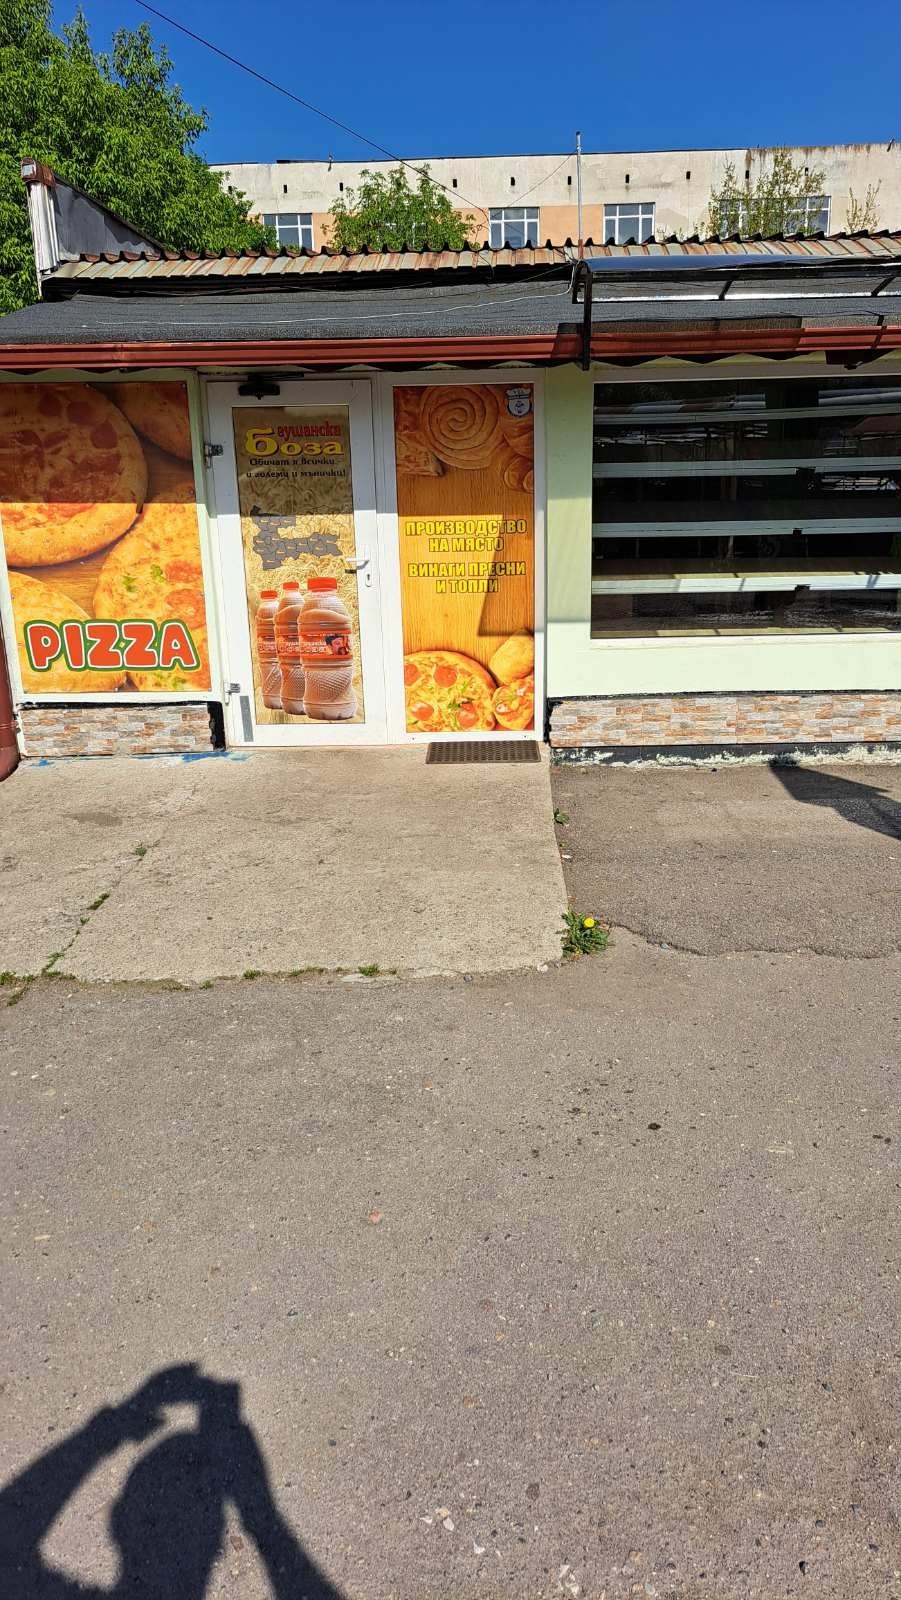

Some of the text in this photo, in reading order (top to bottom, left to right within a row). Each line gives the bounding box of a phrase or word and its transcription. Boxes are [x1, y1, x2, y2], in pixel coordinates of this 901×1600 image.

[405, 519, 527, 536] ПРОИЗВОДСТВО
[429, 537, 504, 552] НА МЯСТО
[408, 561, 526, 577] ВИНАГИ ПРЕСНИ
[436, 578, 499, 593] И ТОПЛИ
[26, 621, 199, 671] PIZZA
